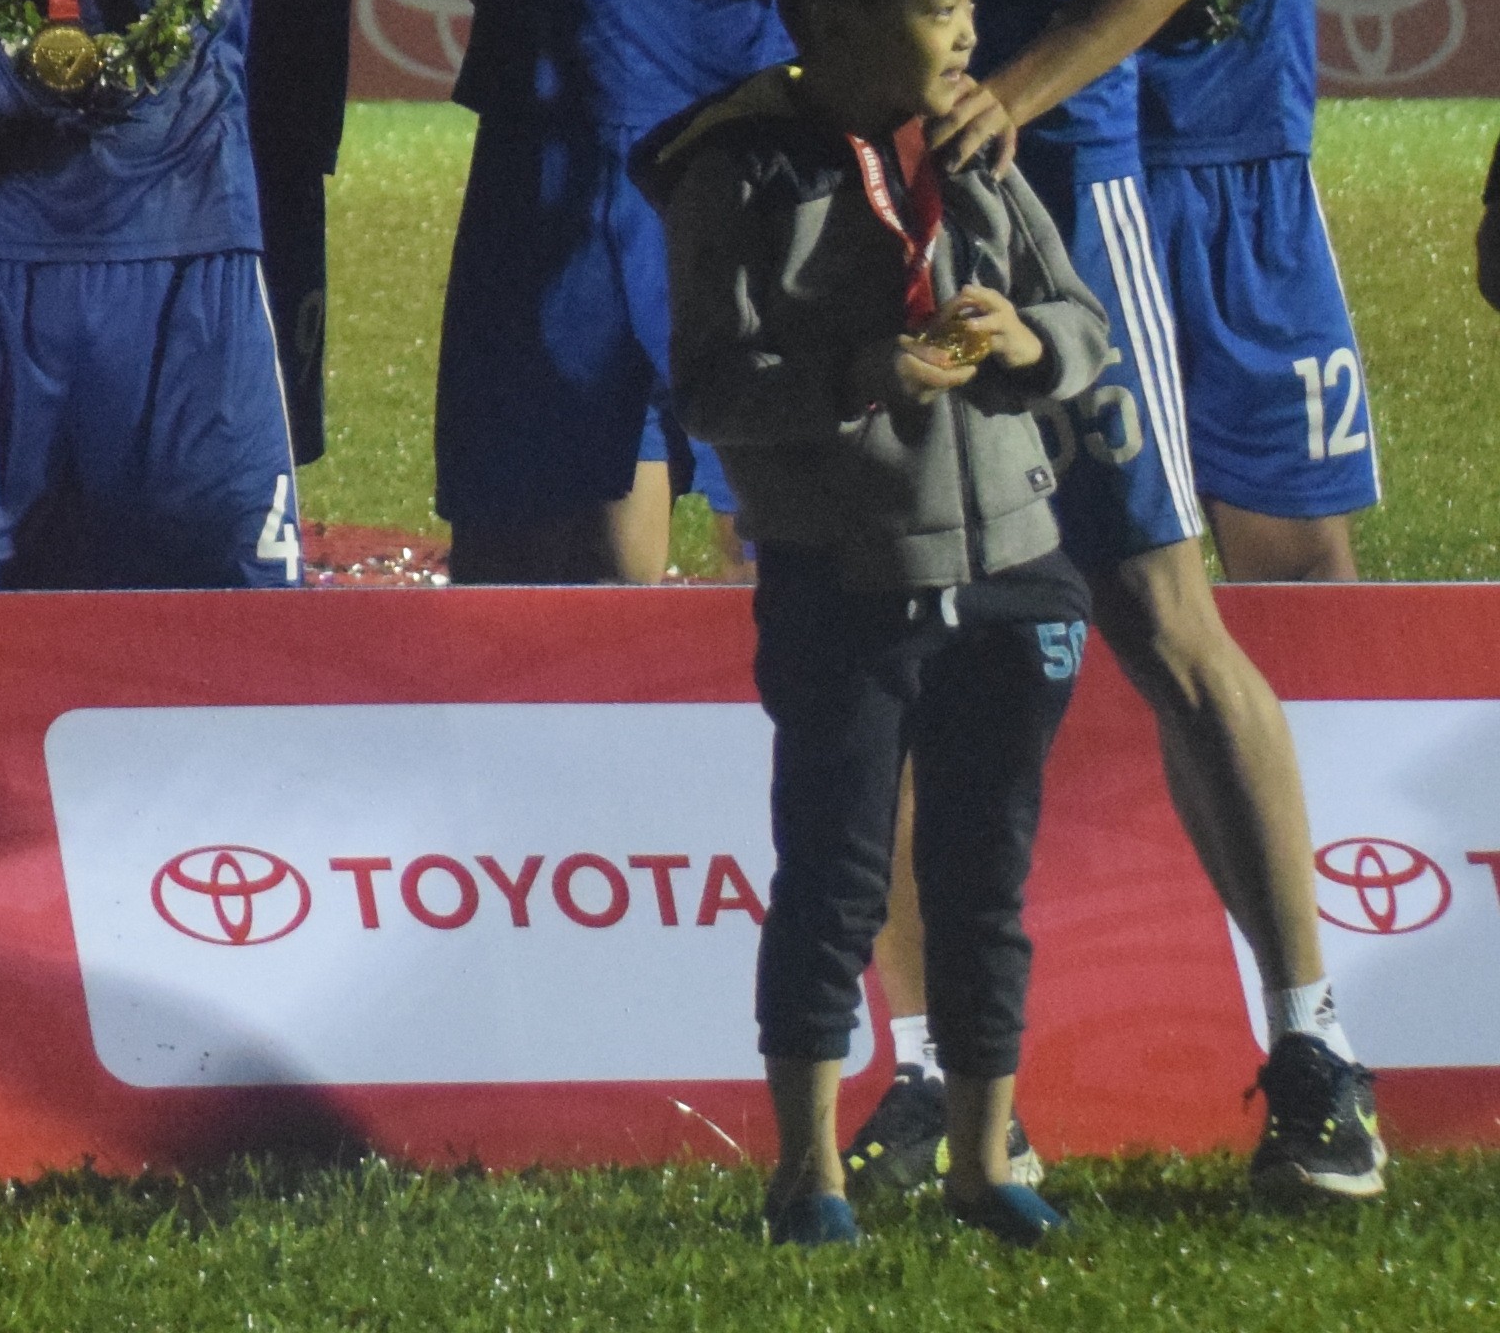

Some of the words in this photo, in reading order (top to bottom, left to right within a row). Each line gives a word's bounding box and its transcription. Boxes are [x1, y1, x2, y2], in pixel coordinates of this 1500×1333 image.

[1293, 345, 1369, 461] 12
[256, 474, 301, 583] 4
[329, 852, 767, 931] TOYOTA
